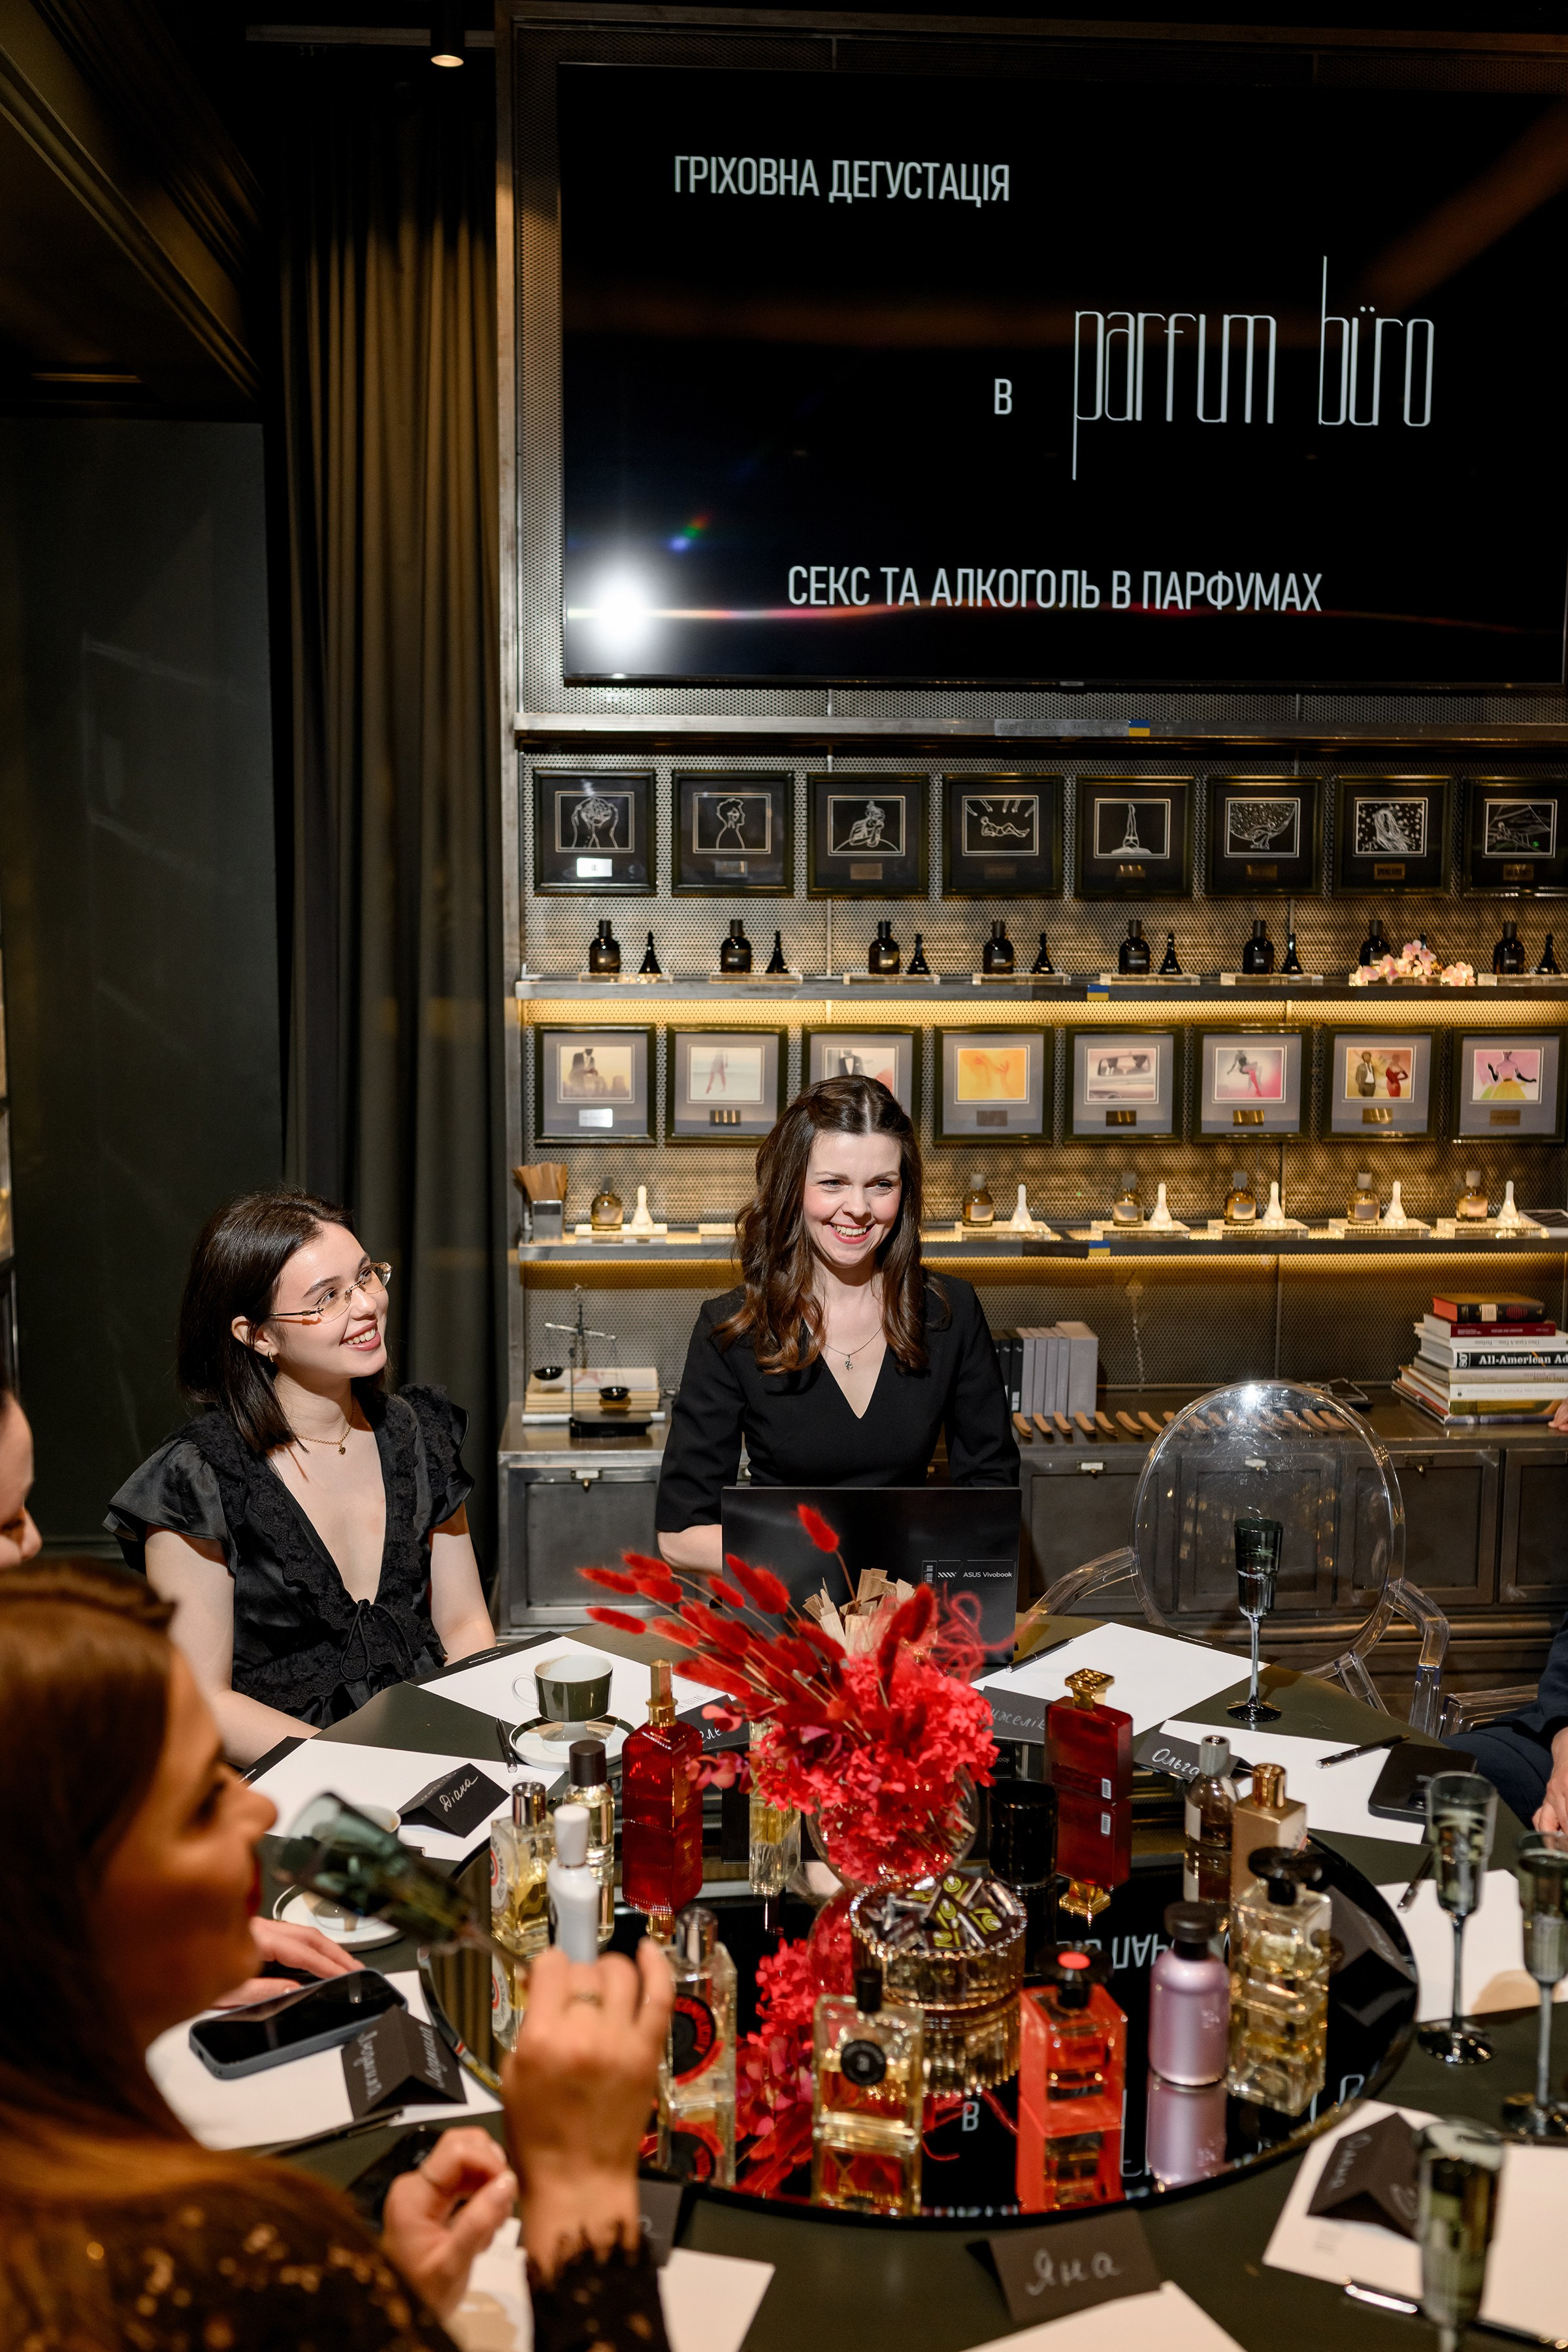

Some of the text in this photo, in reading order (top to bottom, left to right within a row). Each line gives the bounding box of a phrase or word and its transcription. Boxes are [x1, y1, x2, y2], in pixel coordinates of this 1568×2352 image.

[676, 156, 1009, 207] ГРІХОВНА ДЕГУСТАЦІЯ
[1073, 256, 1434, 480] parfum büro
[995, 379, 1011, 414] В
[789, 566, 1321, 611] СЕКС ТА АЛКОГОЛЬ В ПАРФУМАХ
[1478, 1354, 1551, 1365] All-American
